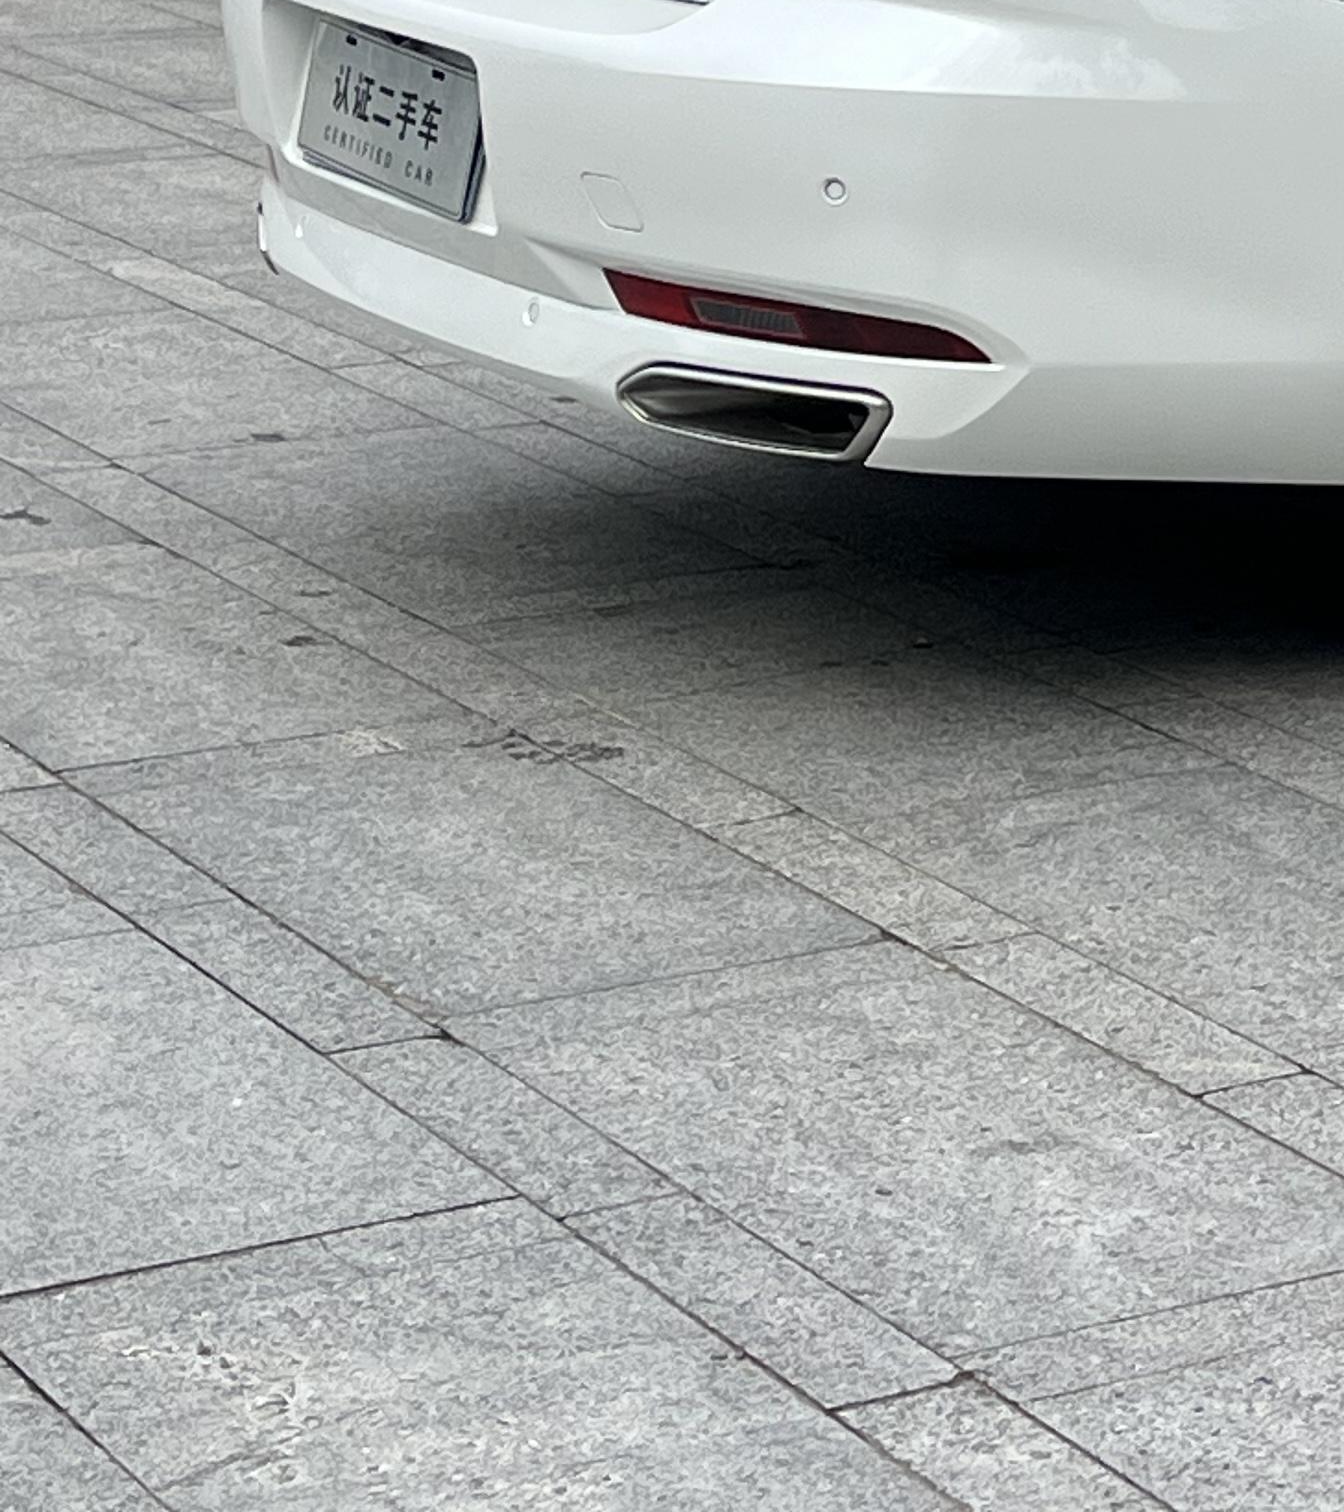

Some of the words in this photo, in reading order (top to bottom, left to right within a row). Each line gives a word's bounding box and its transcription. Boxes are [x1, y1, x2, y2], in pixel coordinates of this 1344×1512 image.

[332, 63, 443, 151] 认证二手车
[323, 124, 393, 170] CERTIFIED
[404, 159, 434, 187] CAR
